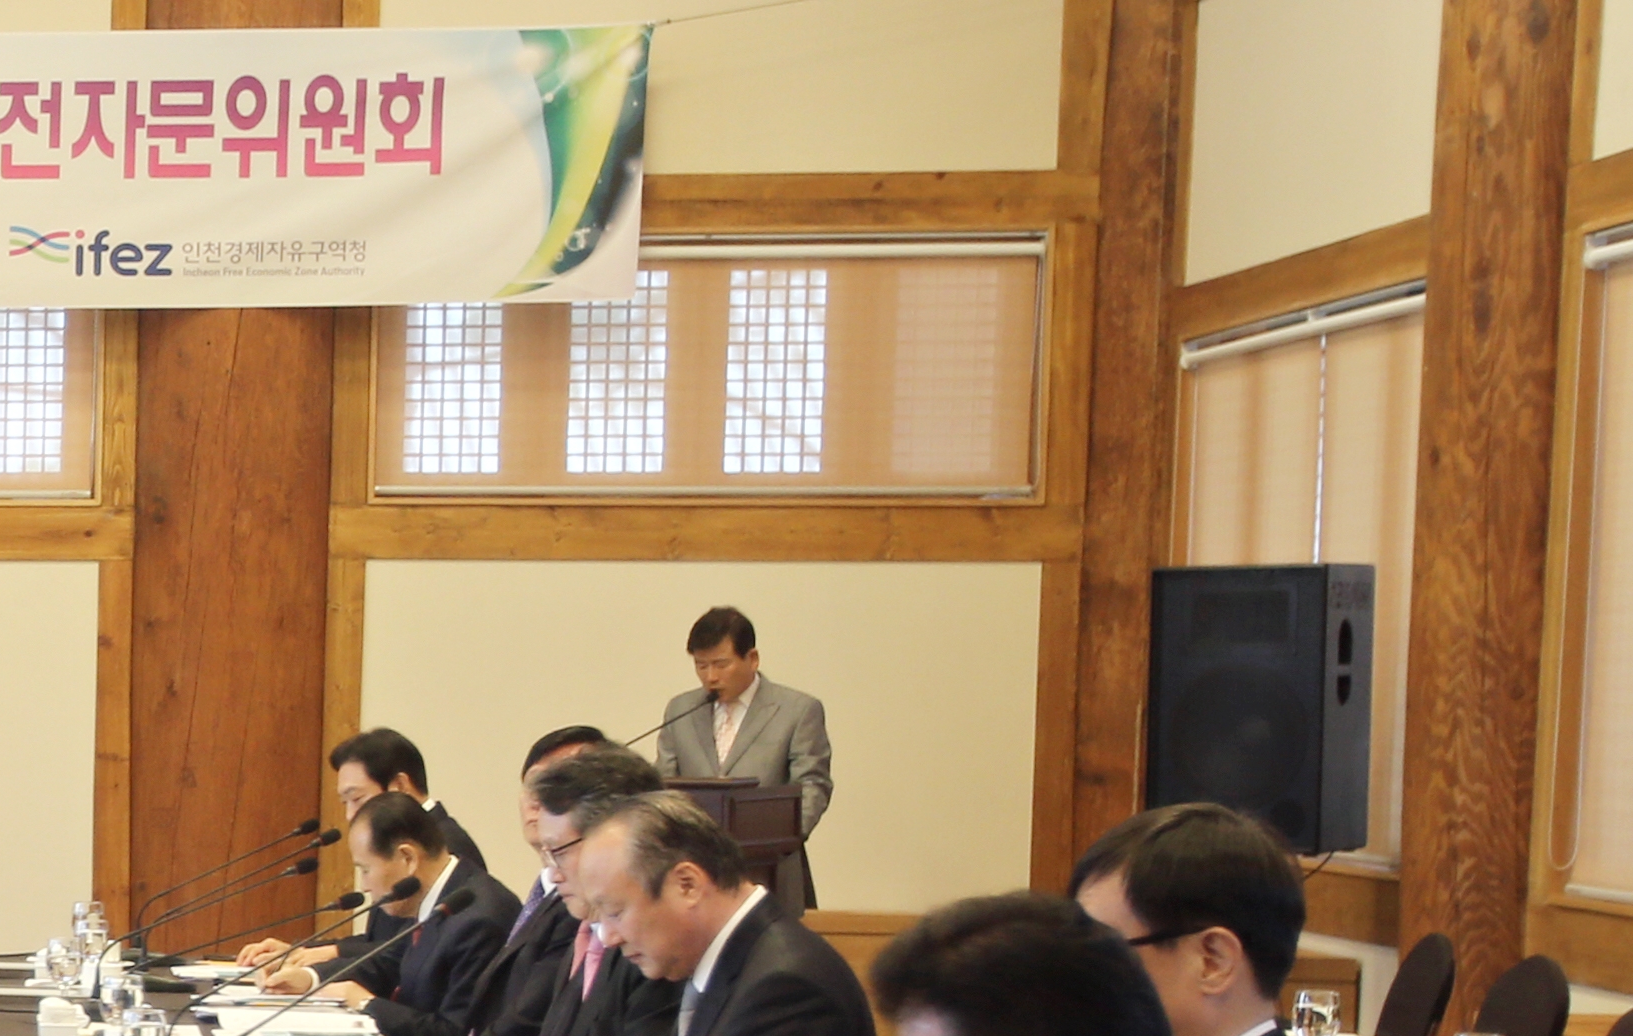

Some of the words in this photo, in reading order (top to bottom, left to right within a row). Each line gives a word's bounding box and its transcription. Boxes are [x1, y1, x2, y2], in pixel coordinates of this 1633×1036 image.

[75, 229, 174, 277] ifez
[182, 240, 366, 264] 인천경제자유구역청
[183, 267, 221, 277] Incheon
[223, 267, 243, 277] Free
[246, 267, 292, 277] Economic
[294, 266, 319, 276] Zone
[321, 265, 366, 277] Authority
